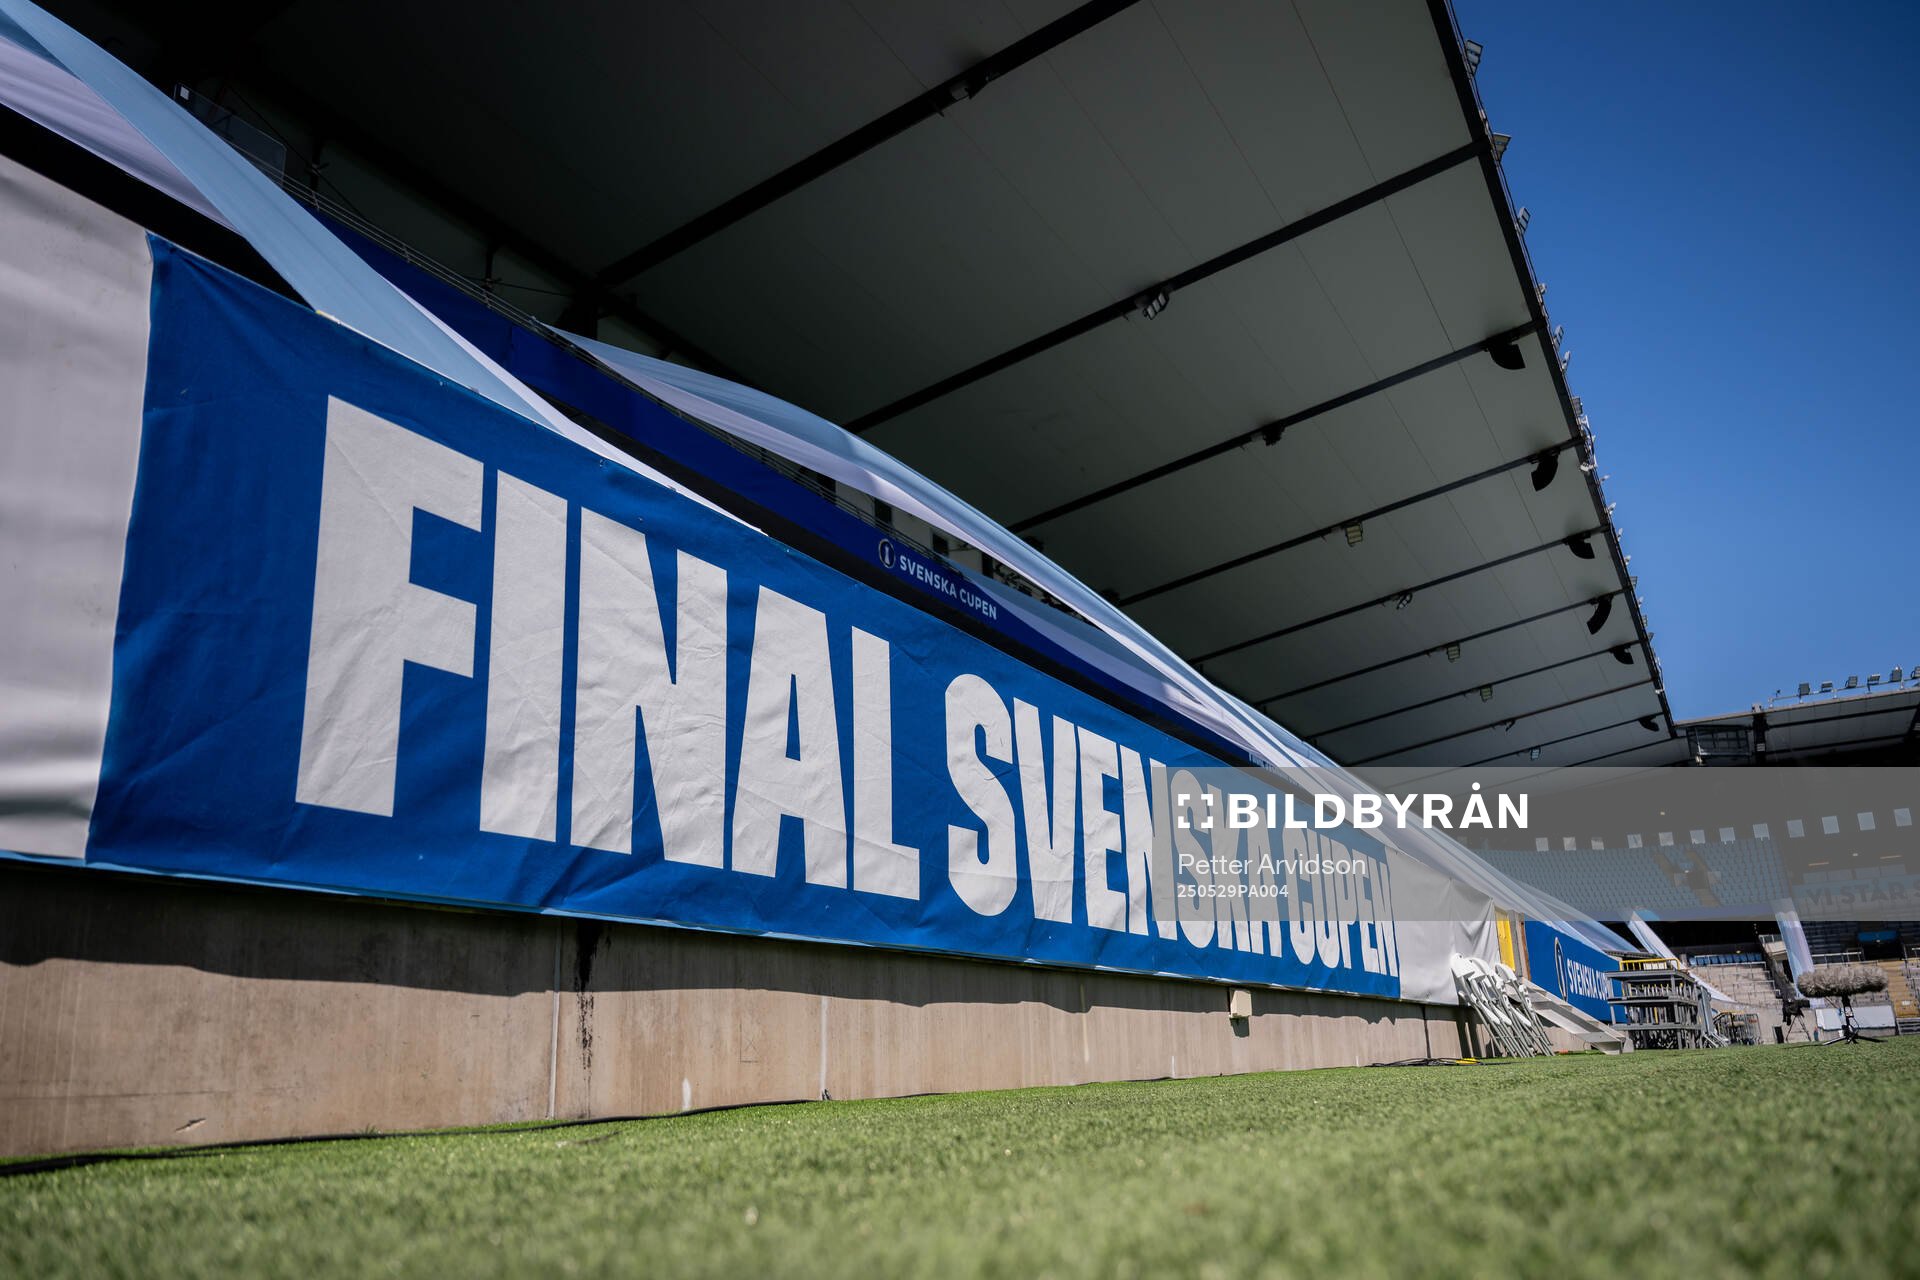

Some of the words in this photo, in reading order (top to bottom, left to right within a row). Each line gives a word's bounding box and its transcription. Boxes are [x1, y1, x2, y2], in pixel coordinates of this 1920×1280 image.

[295, 394, 920, 900] FINAL
[945, 673, 1283, 957] SVENSKA
[1282, 826, 1399, 978] CUPEN
[900, 555, 957, 599] SVENSKA
[960, 588, 997, 620] CUPEN
